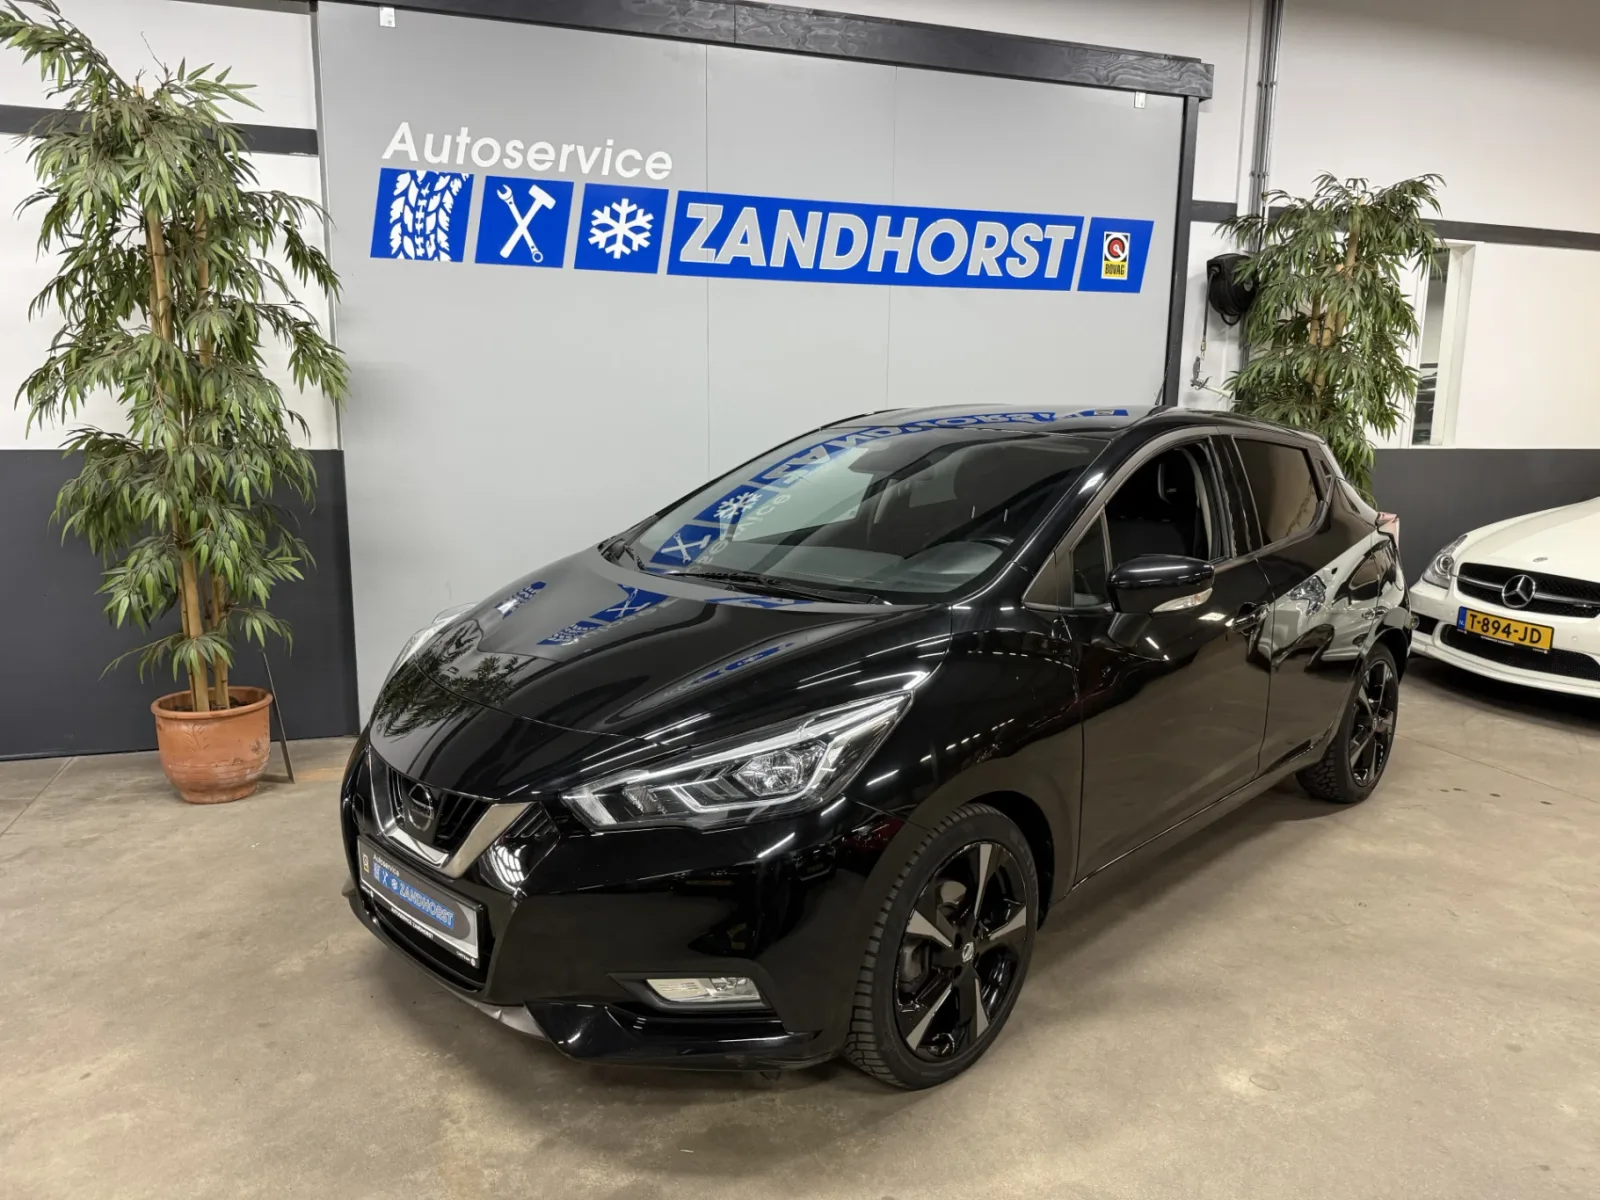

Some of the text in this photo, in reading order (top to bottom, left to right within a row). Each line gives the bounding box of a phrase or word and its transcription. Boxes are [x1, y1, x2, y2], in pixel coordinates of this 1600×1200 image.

[381, 121, 673, 180] Autoservice
[679, 202, 1076, 279] ZANDHORST
[1104, 263, 1125, 275] BOVAG
[1469, 613, 1542, 644] T-894-JD
[399, 883, 454, 926] ZANDHORST
